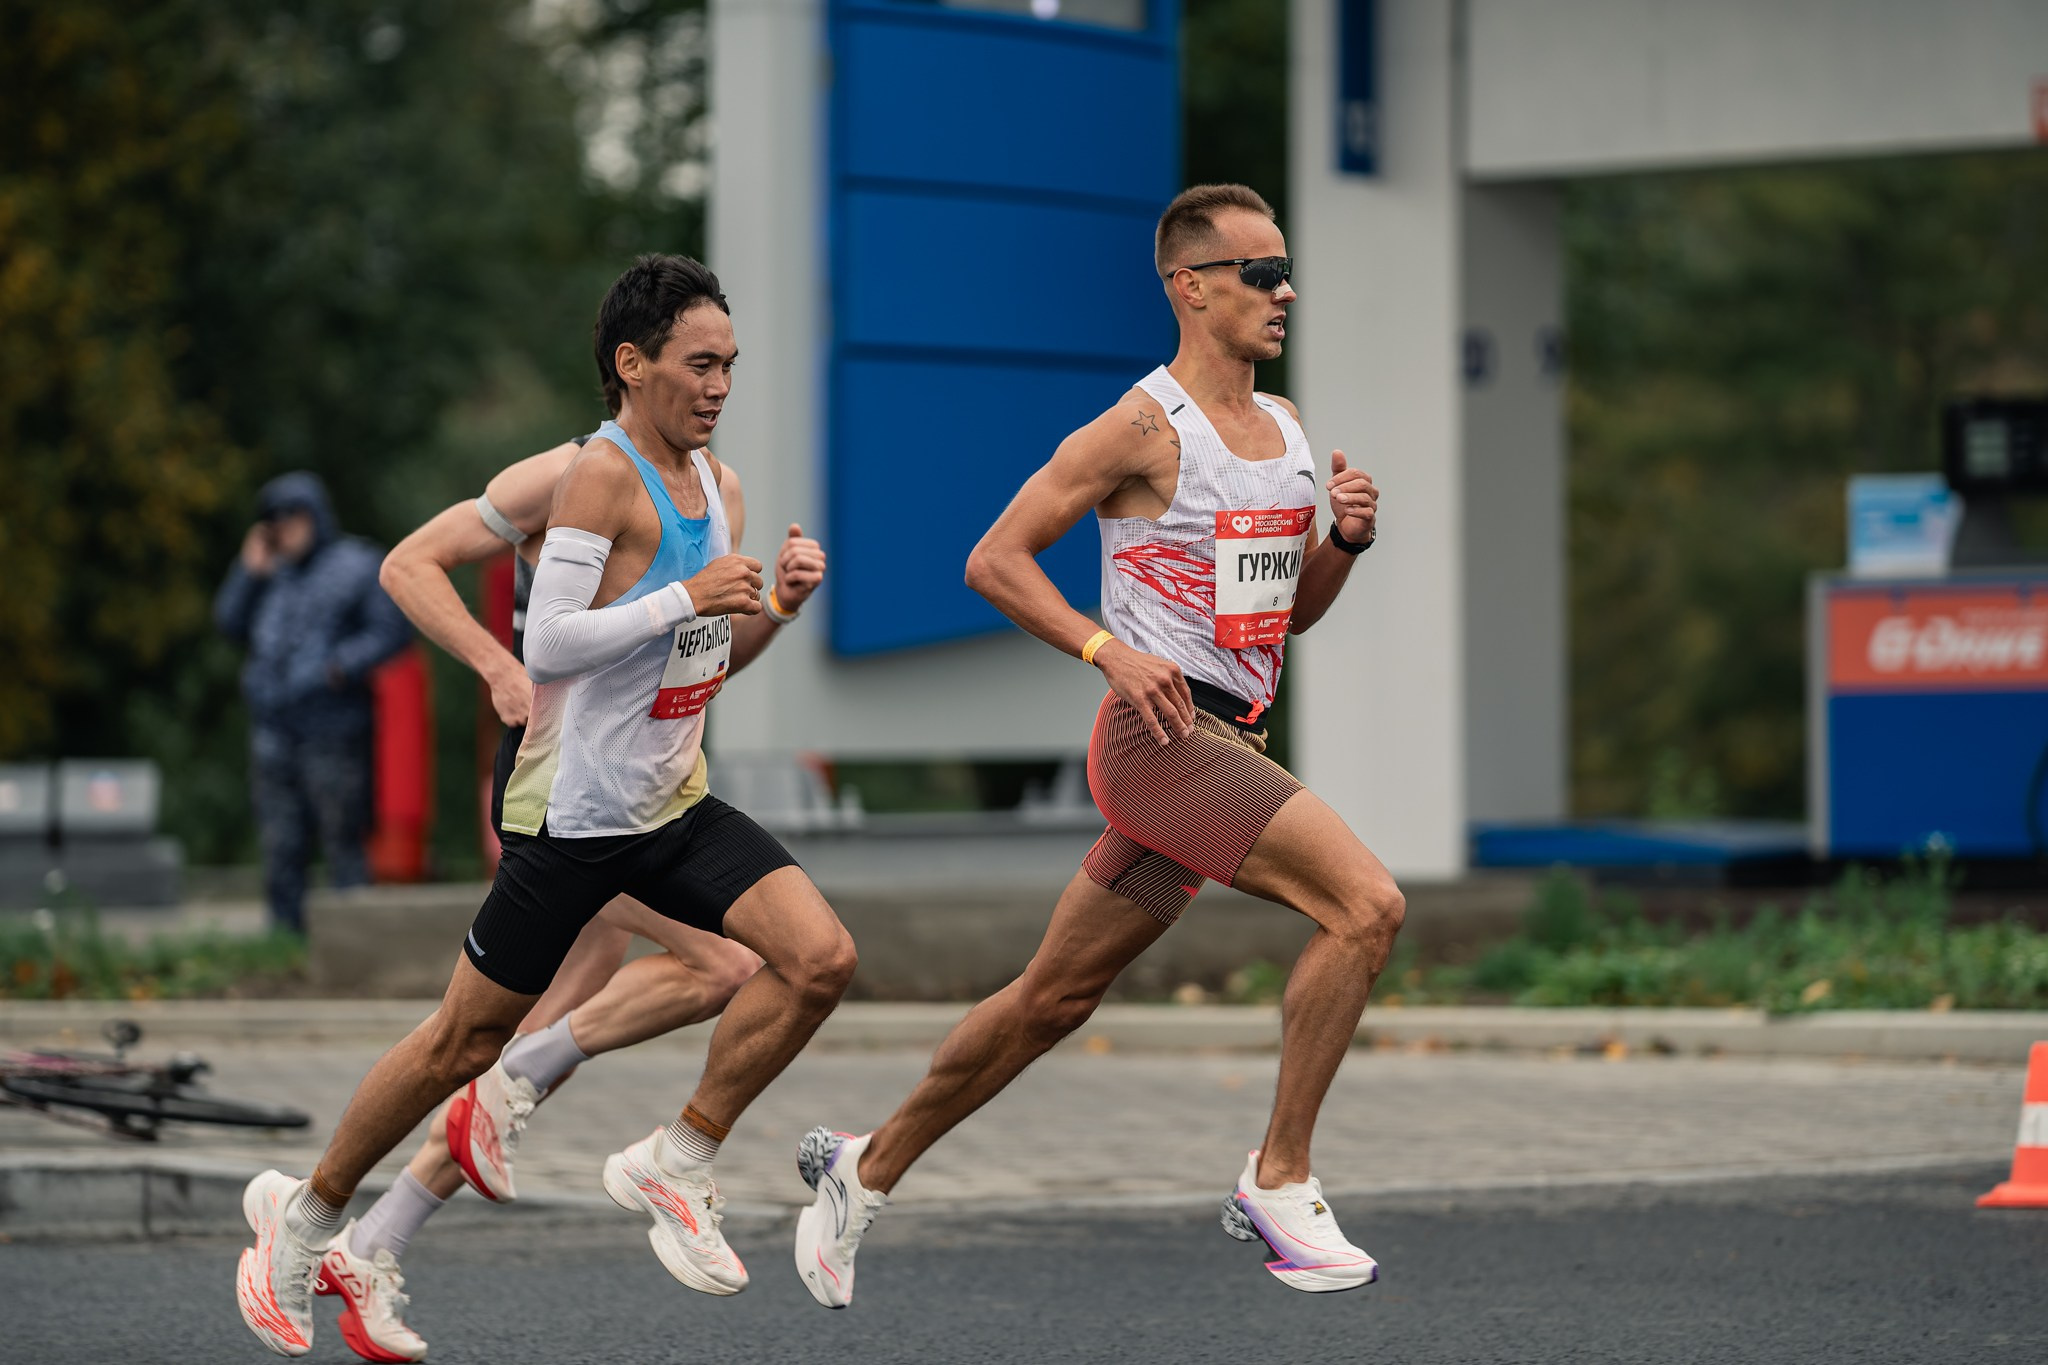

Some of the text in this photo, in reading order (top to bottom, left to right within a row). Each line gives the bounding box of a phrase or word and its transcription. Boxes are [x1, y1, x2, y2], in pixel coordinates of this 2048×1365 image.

[1255, 518, 1293, 527] МОСКОВСКИЙ
[1272, 596, 1278, 606] 8
[677, 615, 730, 658] ЧЕРТЫКОВ
